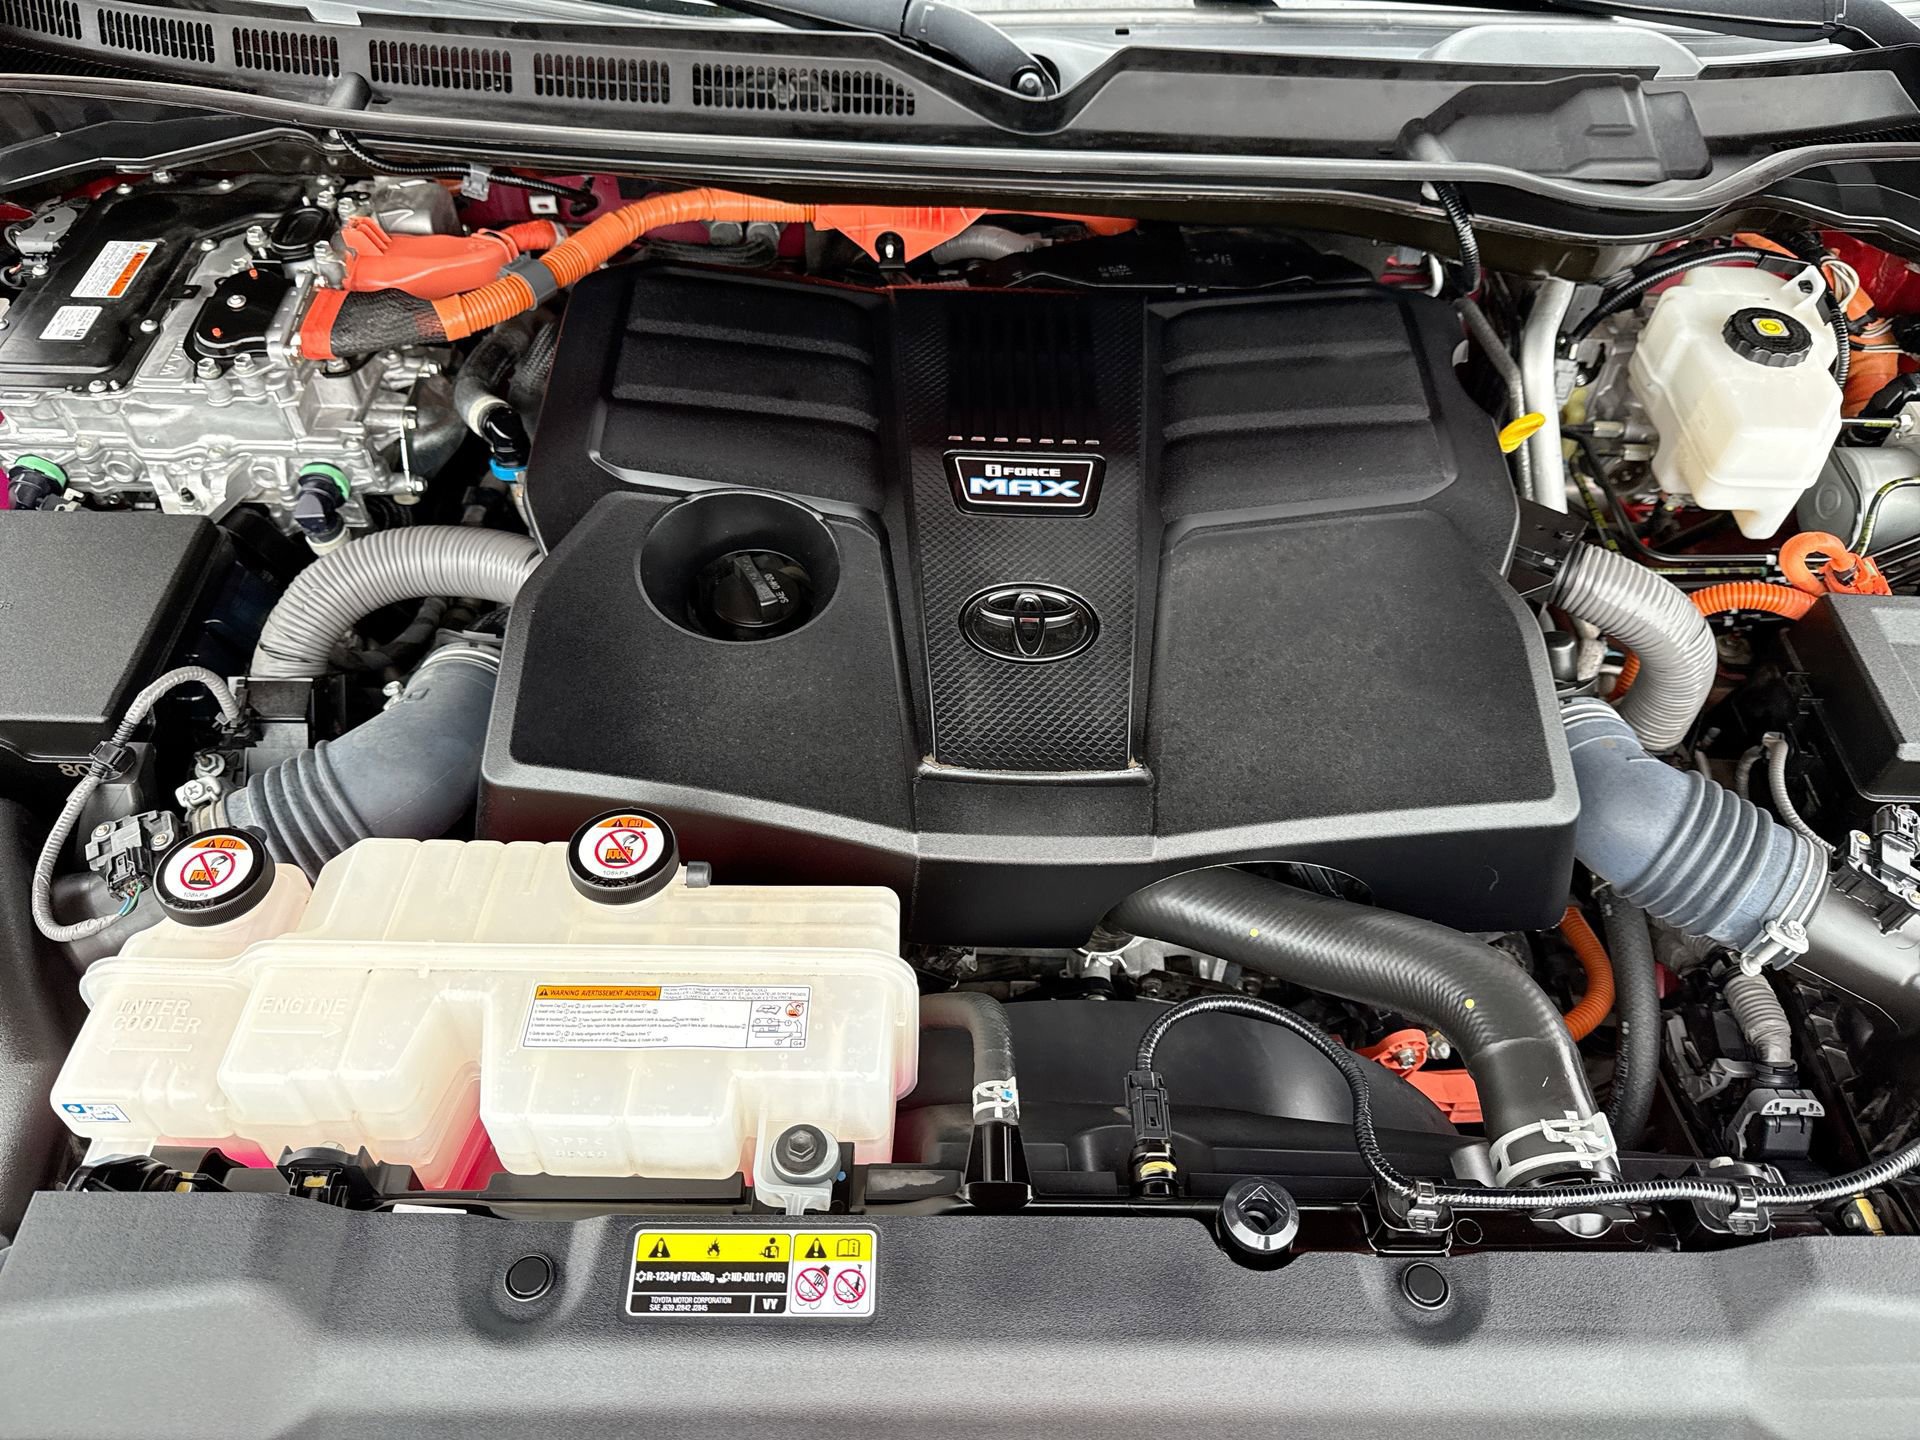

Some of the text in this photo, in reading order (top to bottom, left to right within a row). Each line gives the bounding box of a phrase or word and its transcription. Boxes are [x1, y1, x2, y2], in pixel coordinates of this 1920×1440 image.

[1003, 467, 1061, 477] FORCE
[970, 477, 1081, 498] MAX
[776, 590, 789, 604] SAE
[118, 999, 191, 1016] INTER
[258, 996, 348, 1016] ENGINE
[112, 1015, 202, 1033] COOLER
[646, 1271, 682, 1284] R-1234yf
[765, 1272, 786, 1284] (POE)
[651, 1296, 732, 1304] TOYOTA MOTOR CORPORATION
[762, 1298, 778, 1310] VY
[649, 1304, 661, 1312] SAE
